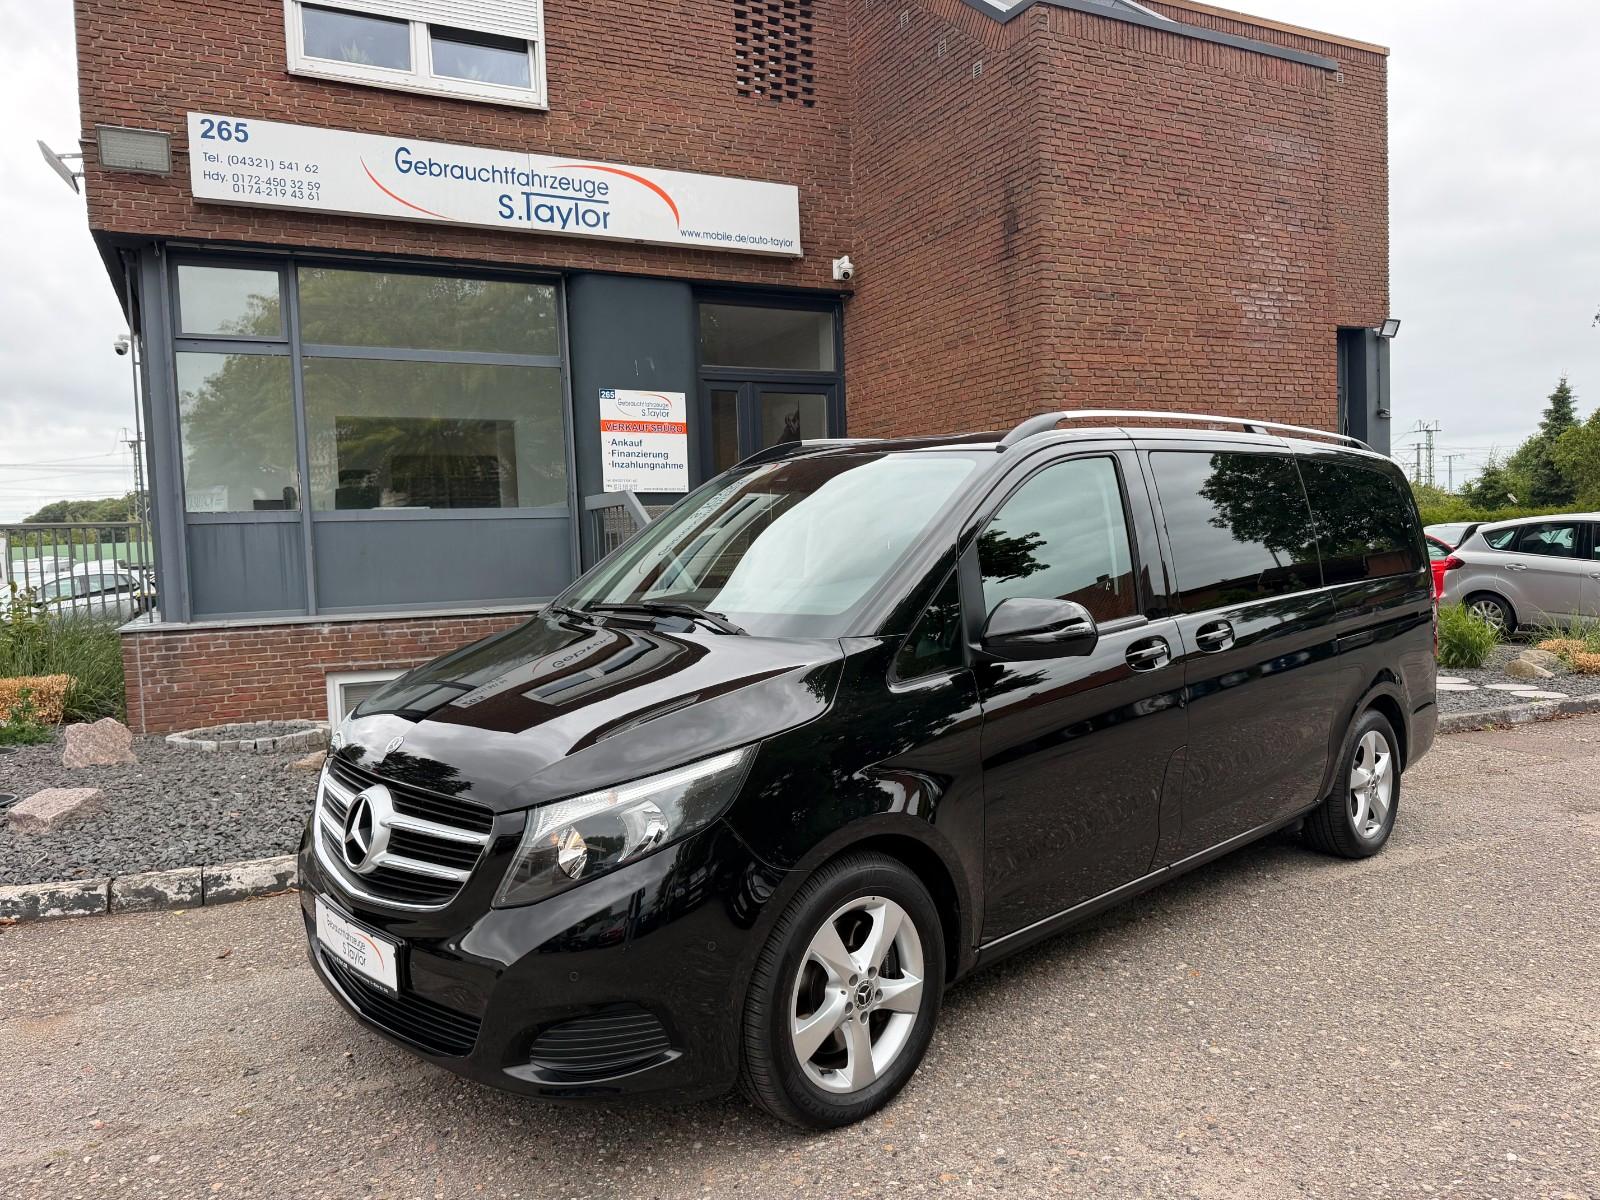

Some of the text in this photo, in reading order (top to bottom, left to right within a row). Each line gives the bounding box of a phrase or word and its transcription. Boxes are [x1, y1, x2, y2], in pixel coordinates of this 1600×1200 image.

[200, 118, 249, 143] 265
[203, 152, 319, 174] Tel. (04321) 541 62
[395, 146, 609, 198] Gebrauchtfahrzeuge
[203, 169, 321, 192] Hdy. 0172-450 32 59
[232, 183, 320, 201] 0174-219 43 61
[498, 191, 610, 230] S.Taylor
[680, 229, 794, 248] www.mobile.de/auto-taylor
[601, 390, 615, 399] 265
[611, 438, 643, 447] Ankauf
[611, 449, 669, 460] Finanzierung
[611, 461, 684, 471] Inzahlungnahme
